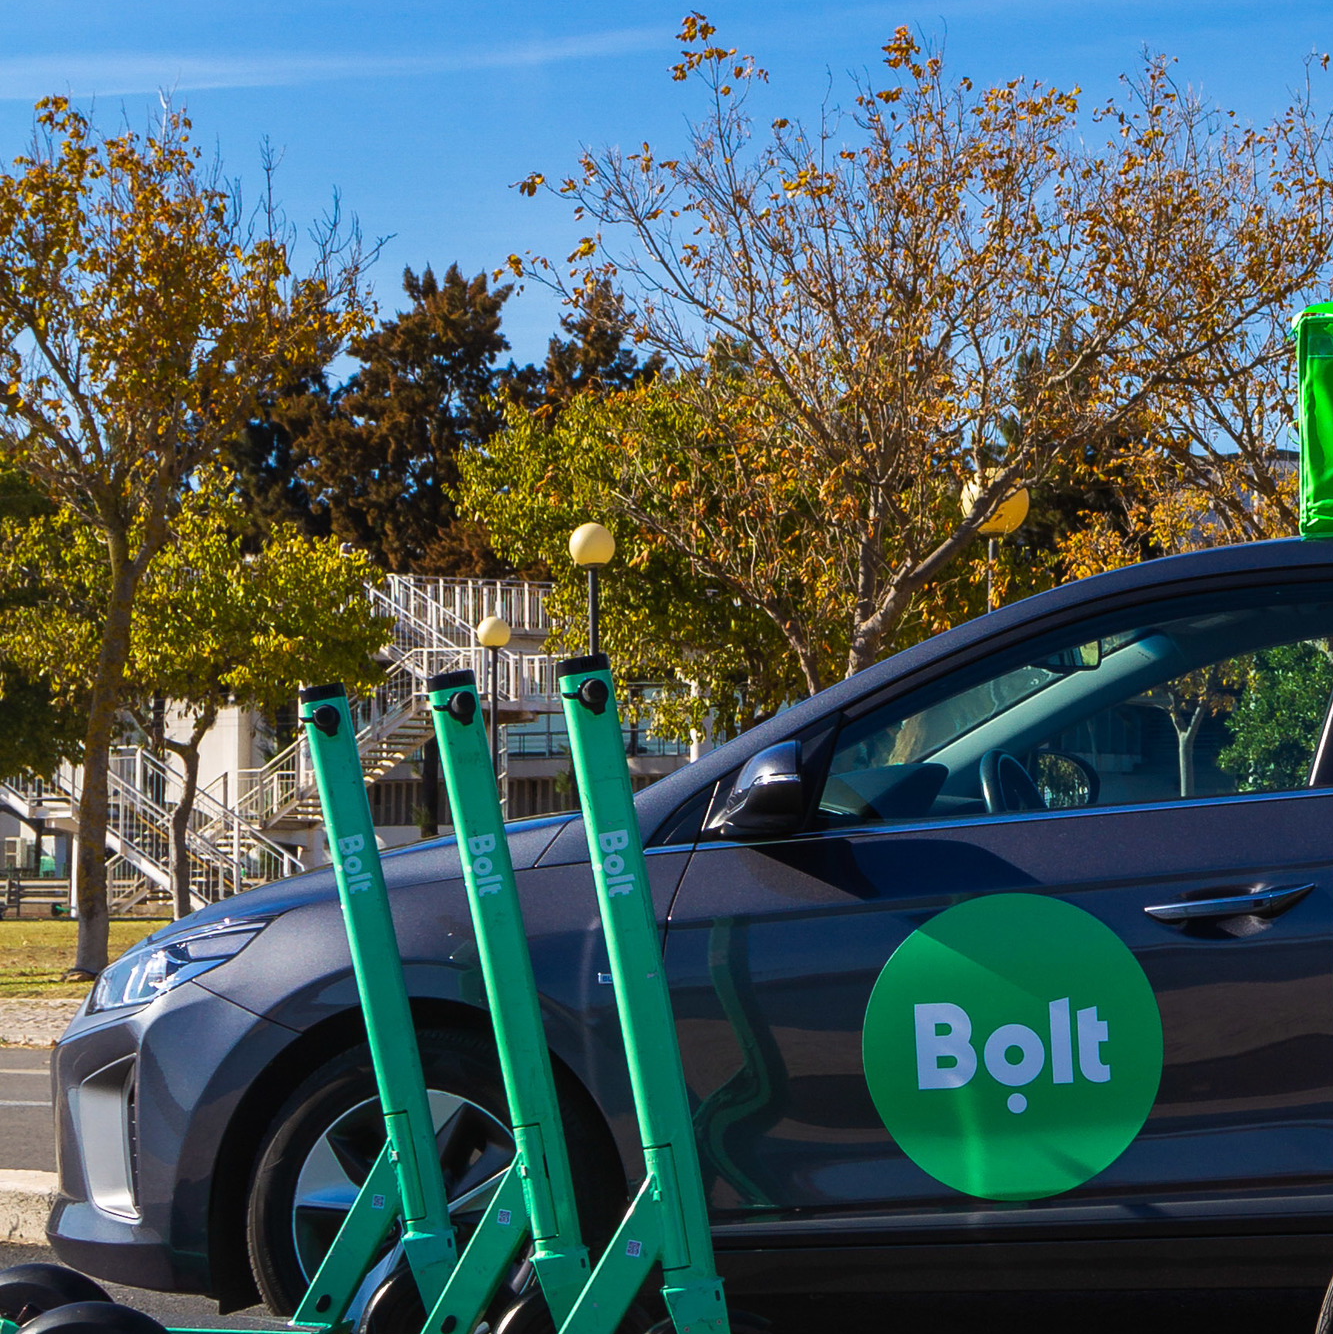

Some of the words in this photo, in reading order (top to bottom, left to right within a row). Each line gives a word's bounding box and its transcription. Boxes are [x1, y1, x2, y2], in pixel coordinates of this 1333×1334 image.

[337, 833, 374, 895] Bolt
[467, 833, 501, 898] Bolt
[598, 829, 636, 898] Bolt
[914, 997, 1111, 1114] Bolt
